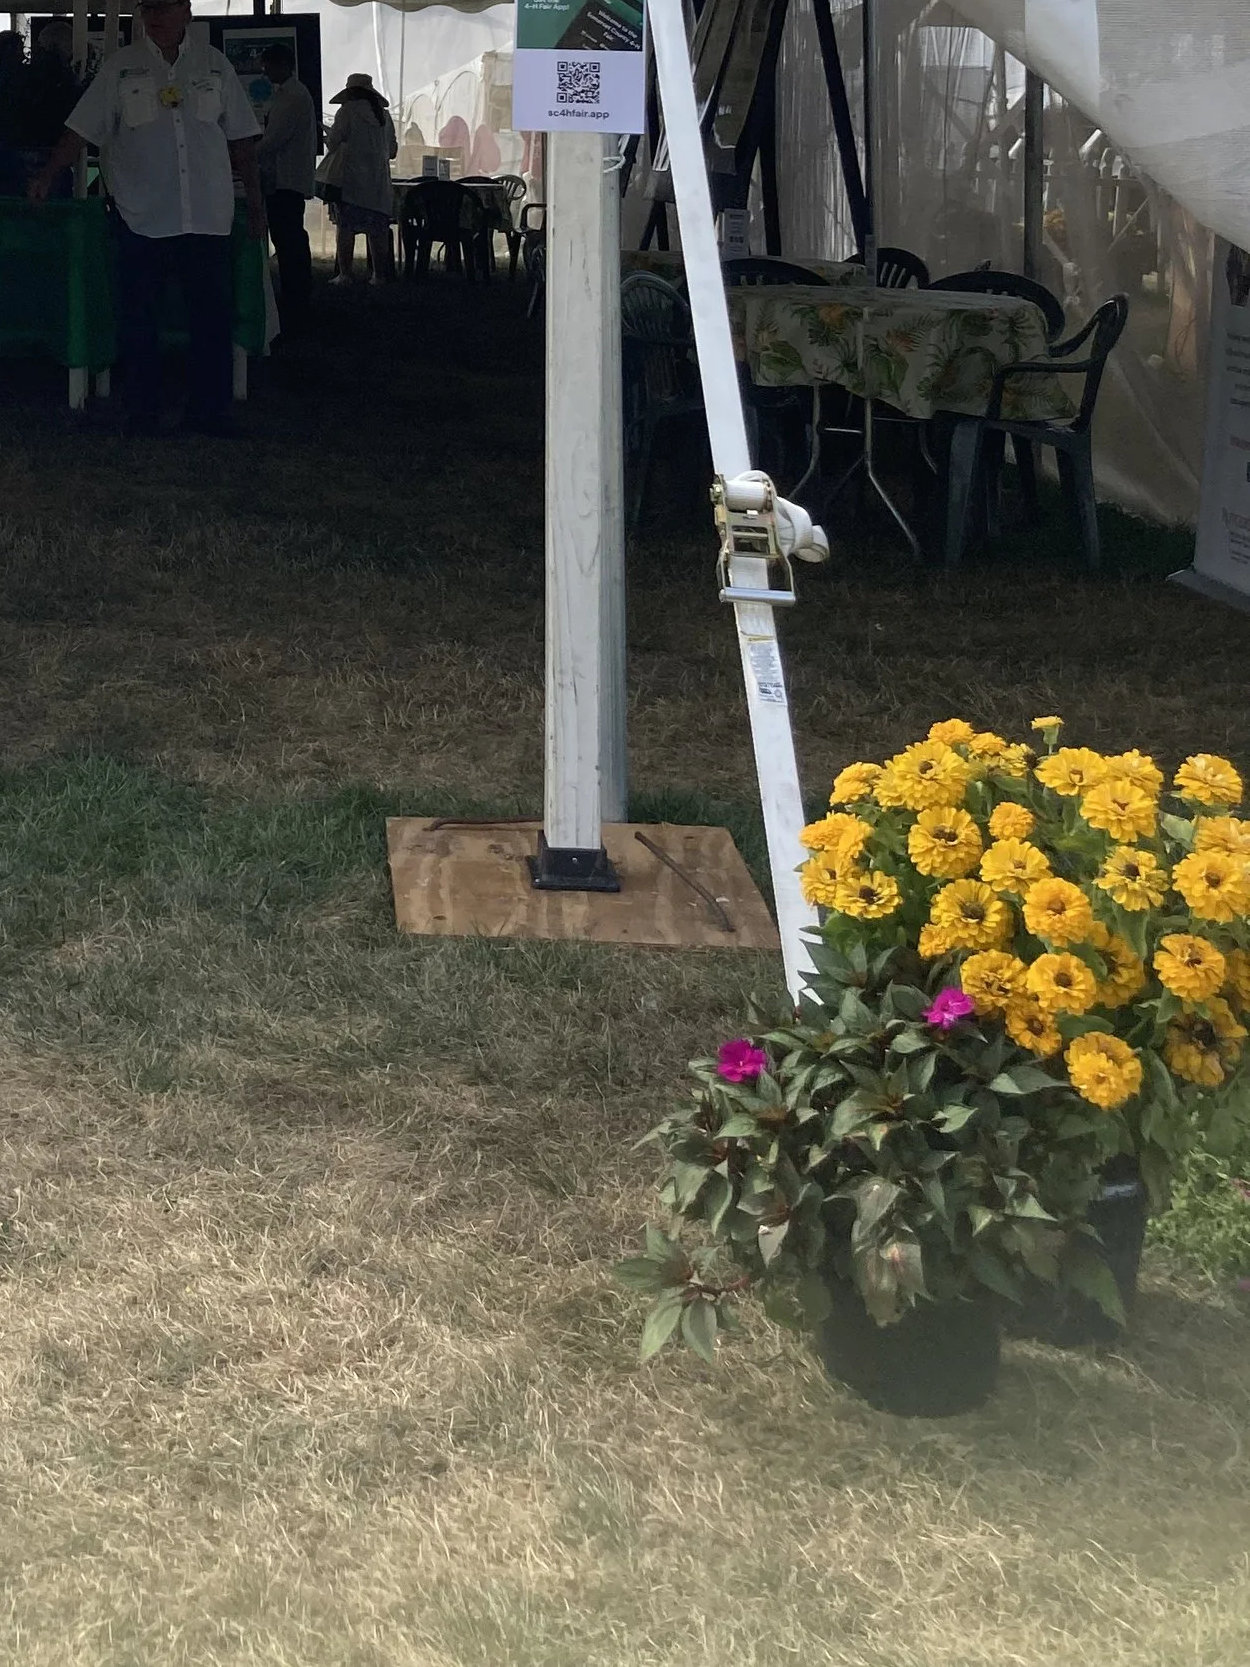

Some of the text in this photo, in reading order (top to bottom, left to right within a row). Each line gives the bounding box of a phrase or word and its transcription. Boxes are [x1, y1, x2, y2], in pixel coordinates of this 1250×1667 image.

[553, 3, 570, 11] App!
[586, 11, 611, 30] Somerset
[610, 27, 630, 43] County
[598, 10, 622, 28] Welcome
[628, 30, 638, 38] the
[603, 31, 614, 41] Fair
[548, 109, 610, 120] sc4hfair.app
